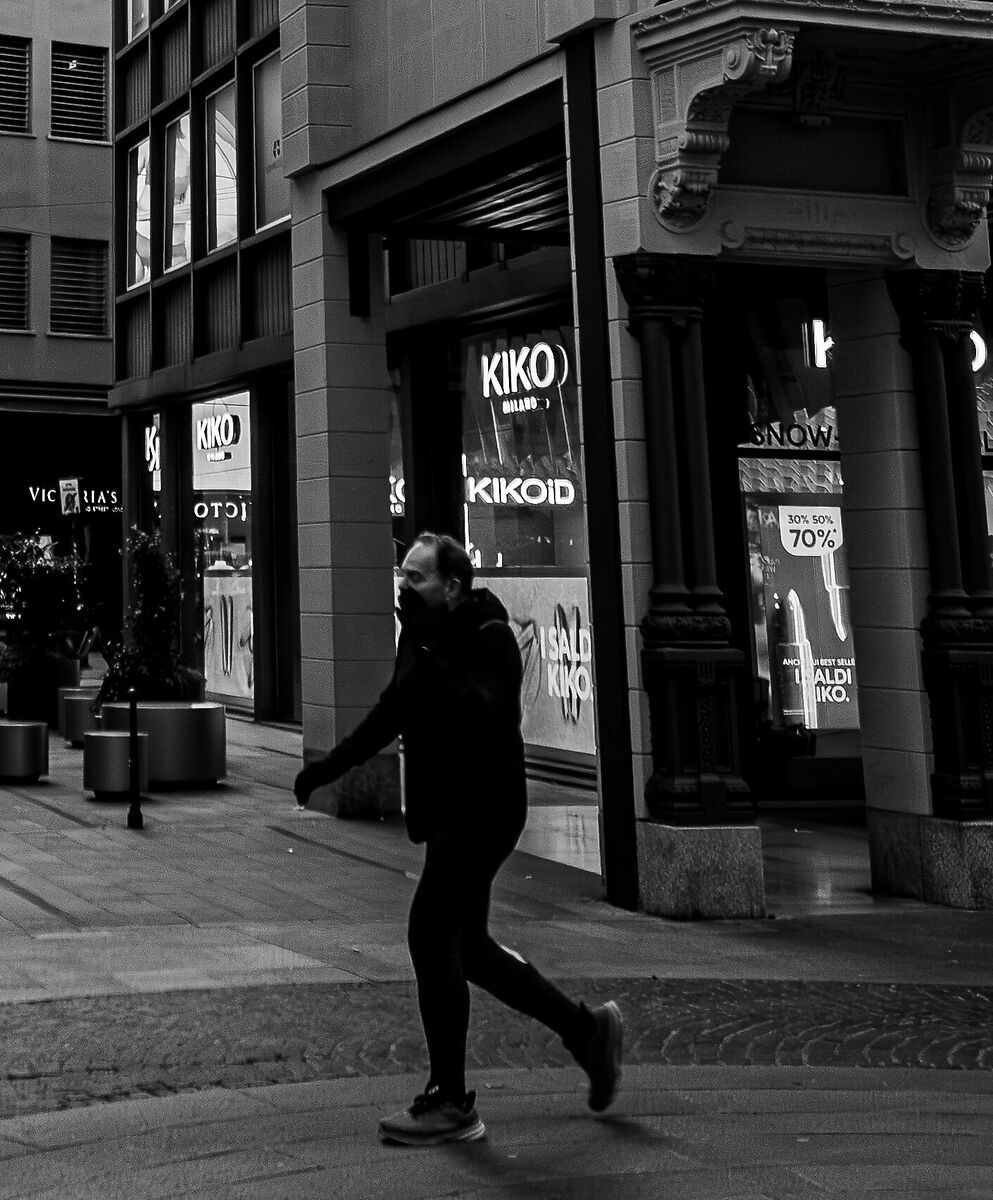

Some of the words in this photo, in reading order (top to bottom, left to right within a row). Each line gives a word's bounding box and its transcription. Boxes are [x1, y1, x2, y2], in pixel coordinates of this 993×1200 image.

[481, 342, 558, 398] KIKO
[196, 413, 235, 451] KIKO
[787, 514, 809, 525] 30%
[812, 514, 834, 525] 50%
[820, 658, 836, 666] BEST
[814, 667, 852, 685] ALDI
[816, 685, 850, 703] IKO.
